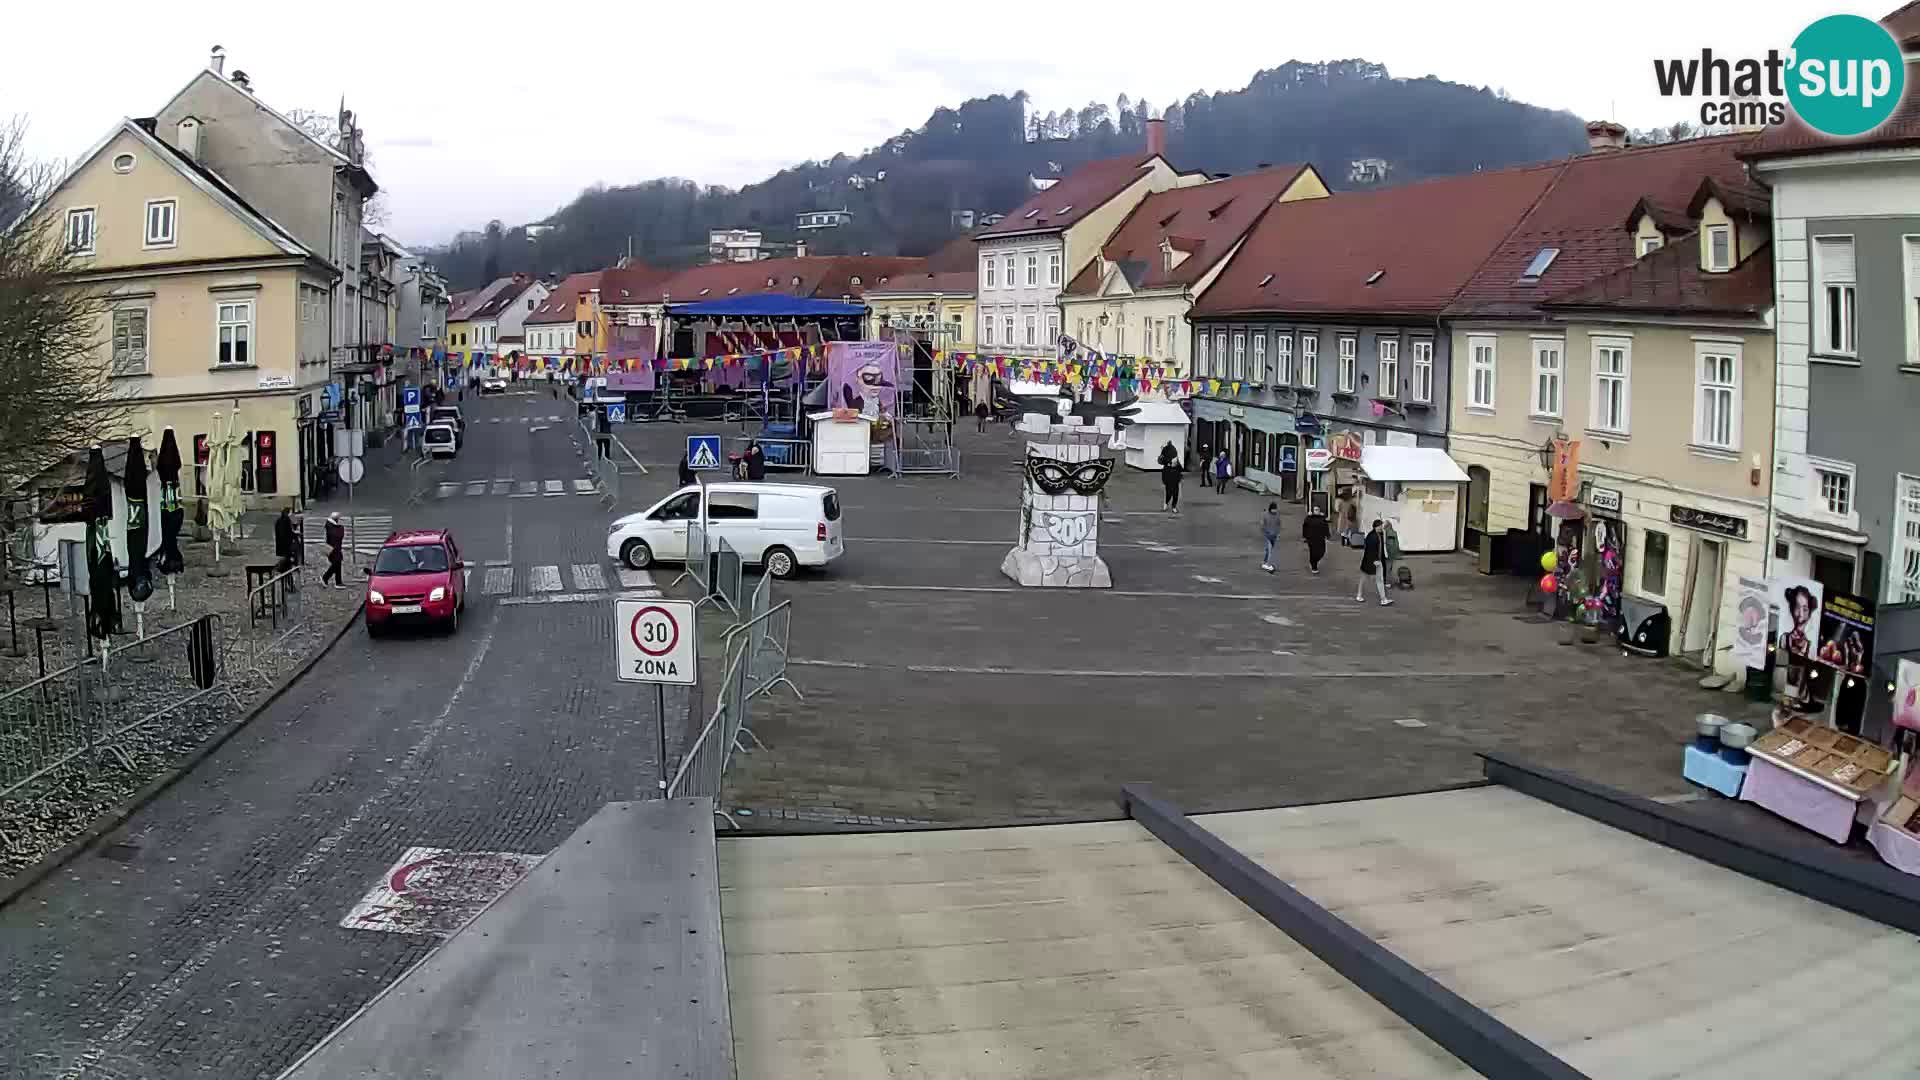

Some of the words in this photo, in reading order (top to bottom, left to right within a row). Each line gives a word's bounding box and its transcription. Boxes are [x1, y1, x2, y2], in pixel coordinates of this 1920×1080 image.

[408, 392, 416, 402] P
[1048, 516, 1087, 545] 200
[643, 622, 667, 643] 30
[634, 660, 678, 676] ZONA
